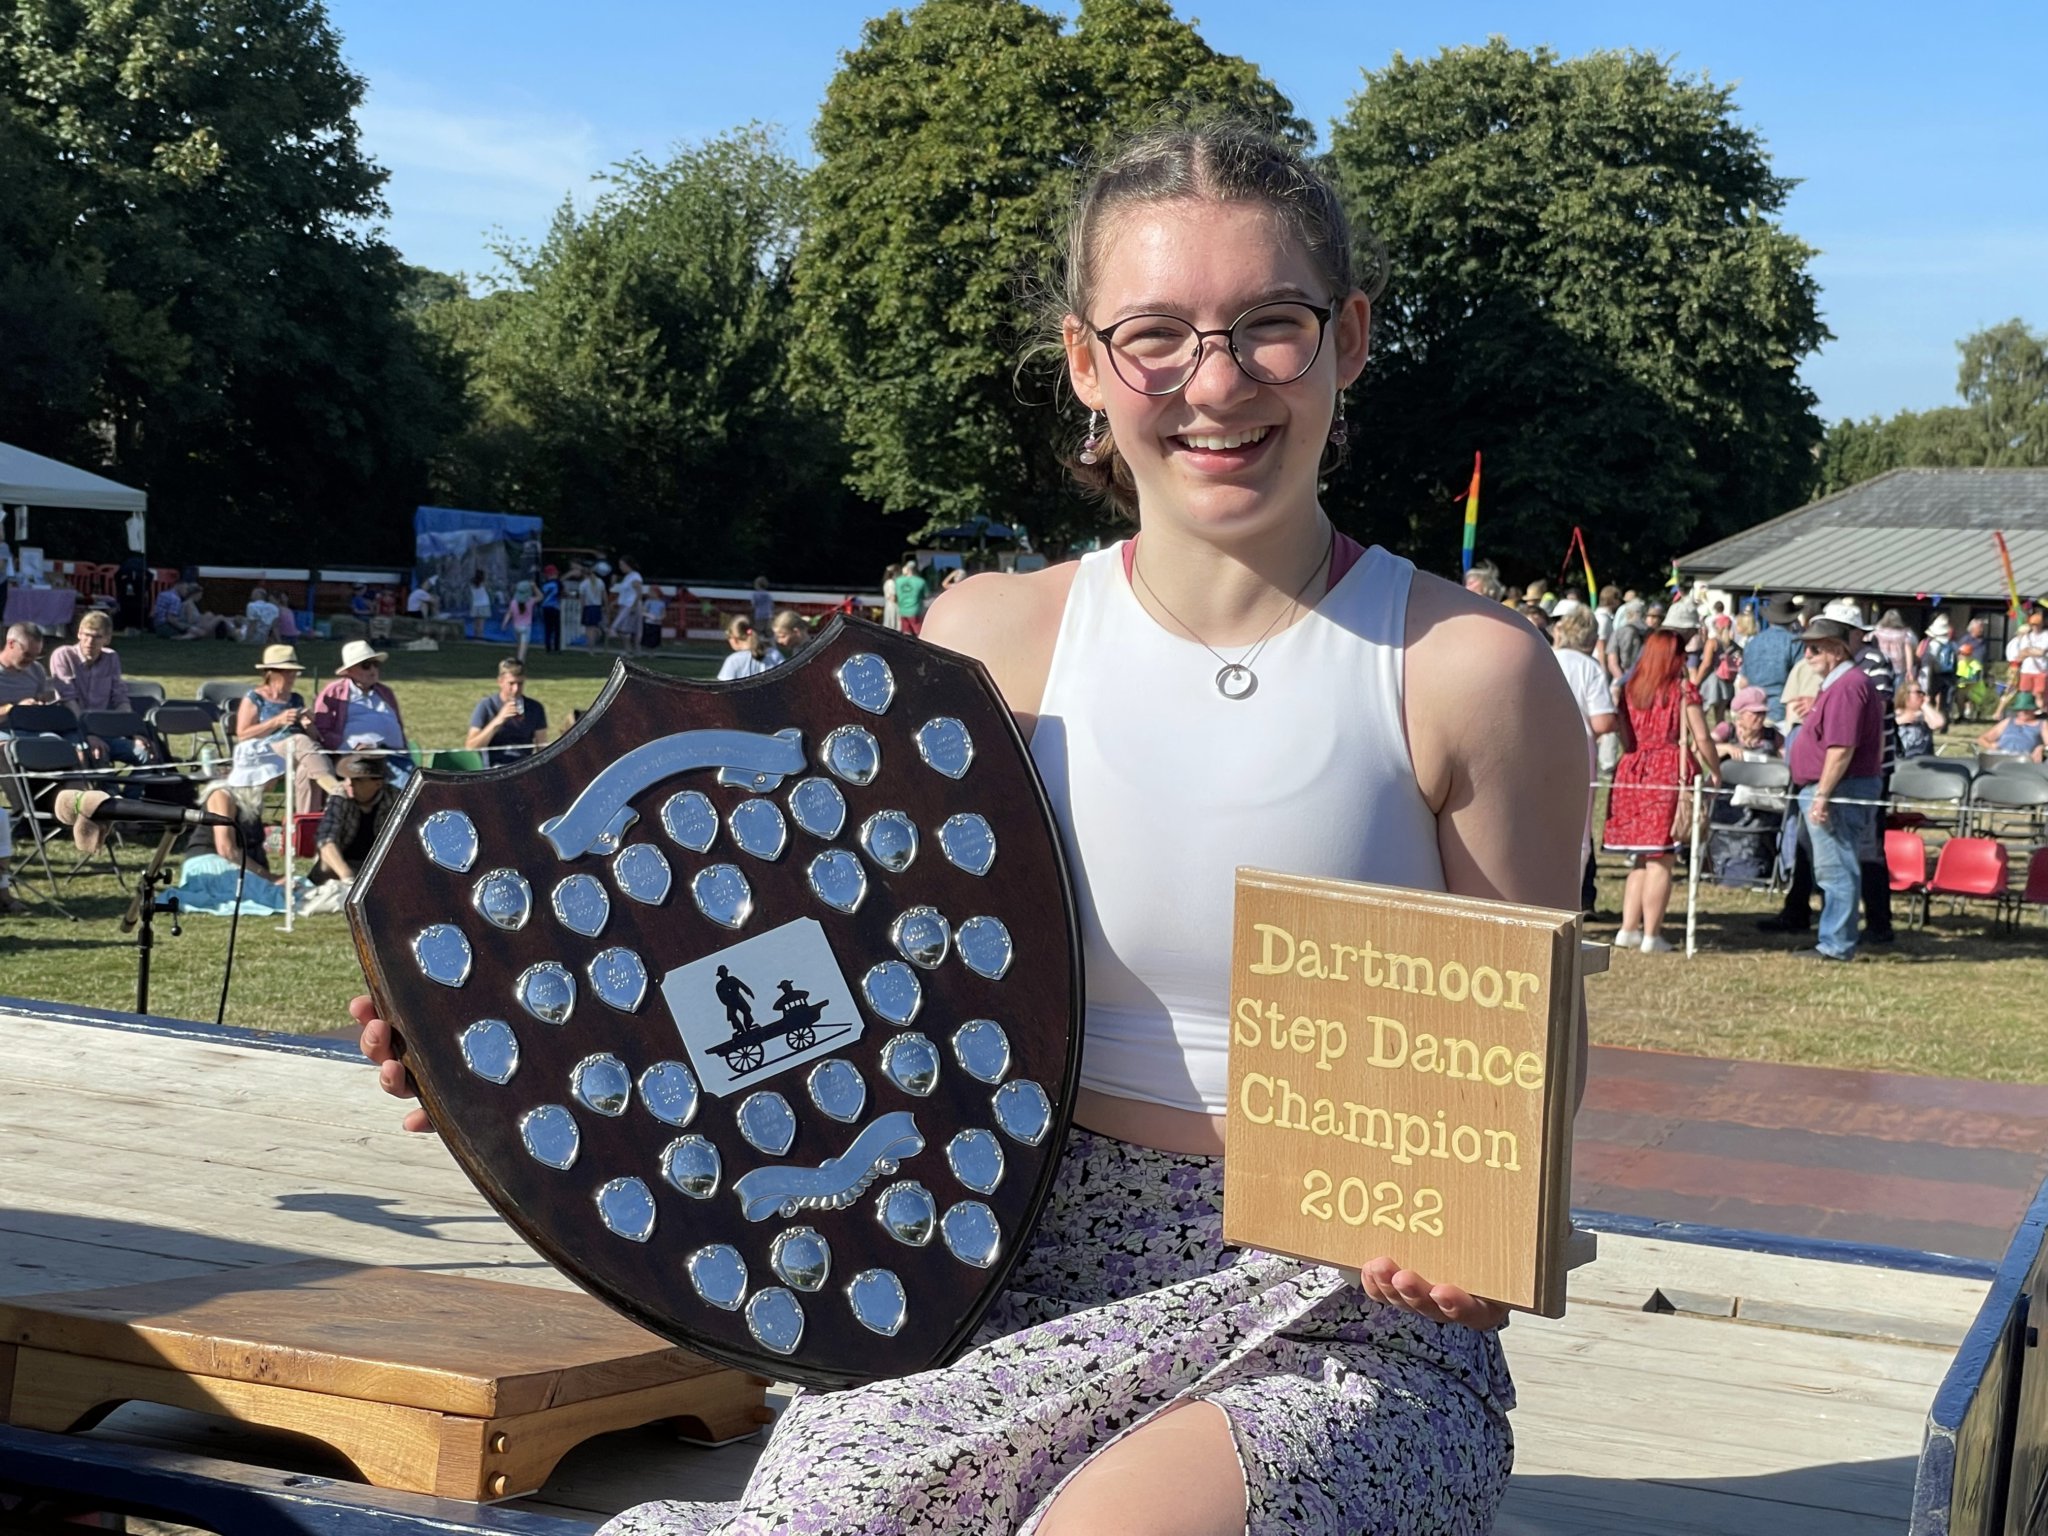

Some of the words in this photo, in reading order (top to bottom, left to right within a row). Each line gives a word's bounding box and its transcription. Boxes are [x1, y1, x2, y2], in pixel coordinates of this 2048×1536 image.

[1249, 923, 1540, 1010] Dartmoor
[1234, 997, 1348, 1071] Step
[1366, 1015, 1545, 1090] Dance
[1240, 1072, 1522, 1172] Champion
[1300, 1168, 1444, 1237] 2022
